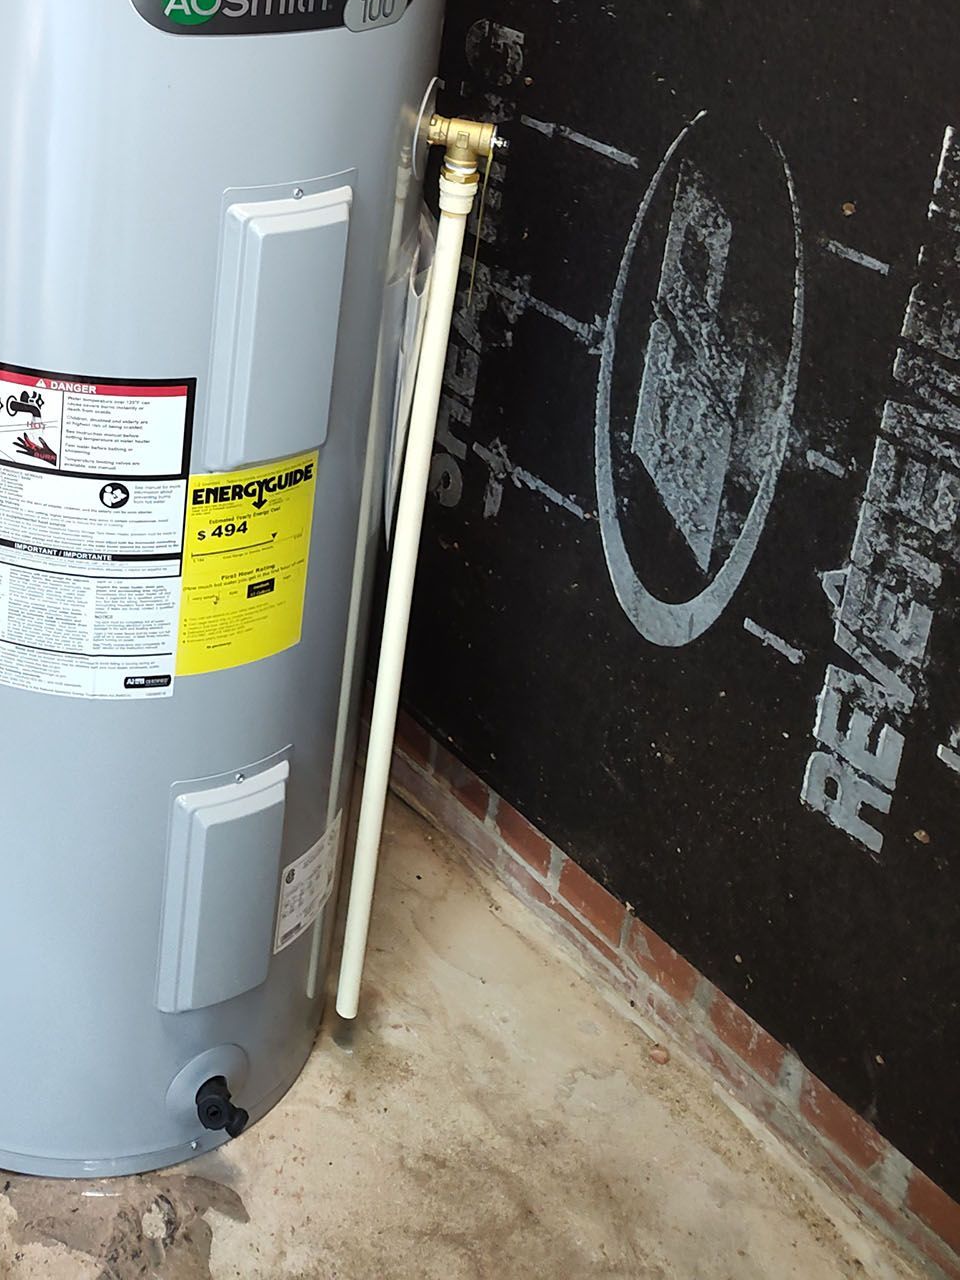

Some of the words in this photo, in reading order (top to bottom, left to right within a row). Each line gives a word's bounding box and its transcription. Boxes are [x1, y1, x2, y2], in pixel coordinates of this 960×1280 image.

[50, 381, 97, 394] DANGER
[211, 520, 248, 538] 494
[14, 542, 58, 556] IMPORTANT
[63, 551, 113, 561] IMPORTANTE
